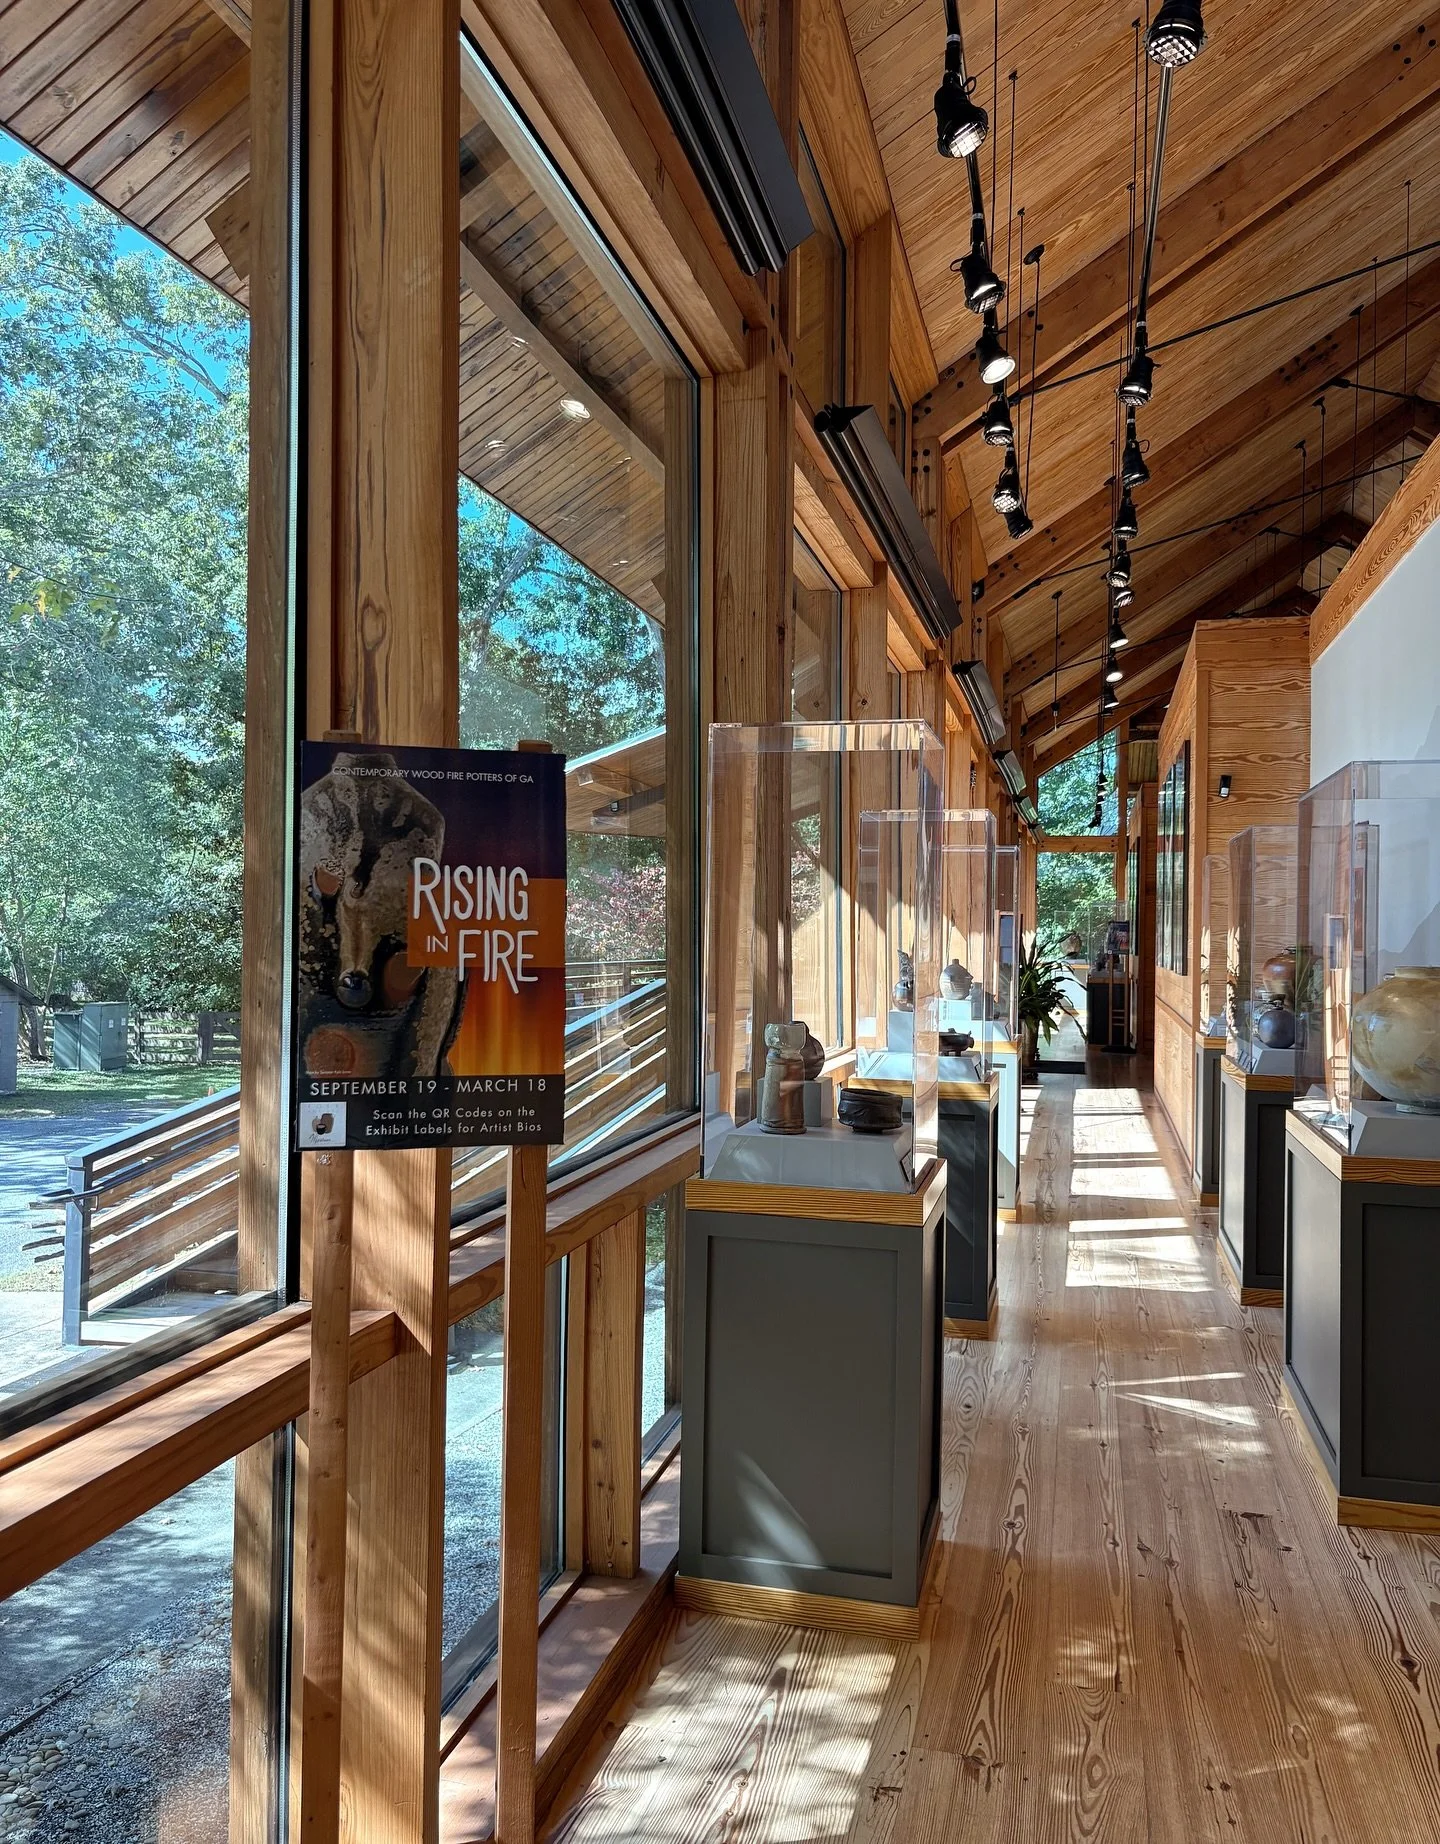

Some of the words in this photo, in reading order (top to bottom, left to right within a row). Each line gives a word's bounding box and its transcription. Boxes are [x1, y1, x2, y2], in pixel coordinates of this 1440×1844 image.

[332, 767, 409, 778] CONTEMPORARY
[411, 770, 445, 779] WOOD
[447, 771, 464, 780] FIRE
[466, 772, 503, 782] POTTERS
[505, 774, 517, 783] OF
[519, 775, 534, 784] GA
[413, 857, 529, 934] RISING
[426, 935, 449, 953] IN
[458, 929, 539, 994] FIRE
[310, 1081, 408, 1096] SEPTEMBER
[417, 1080, 437, 1094] 19
[456, 1079, 518, 1093] MARCH
[528, 1078, 547, 1092] 18
[373, 1109, 403, 1120] Scan
[408, 1108, 427, 1119] the
[432, 1108, 450, 1118] QR
[455, 1106, 493, 1118] Codes
[498, 1109, 512, 1117] on
[517, 1106, 535, 1117] the
[365, 1124, 409, 1136] Exhibit
[414, 1122, 453, 1134] Labels
[458, 1122, 475, 1133] for
[480, 1122, 512, 1132] Artist
[517, 1121, 542, 1132] Bios
